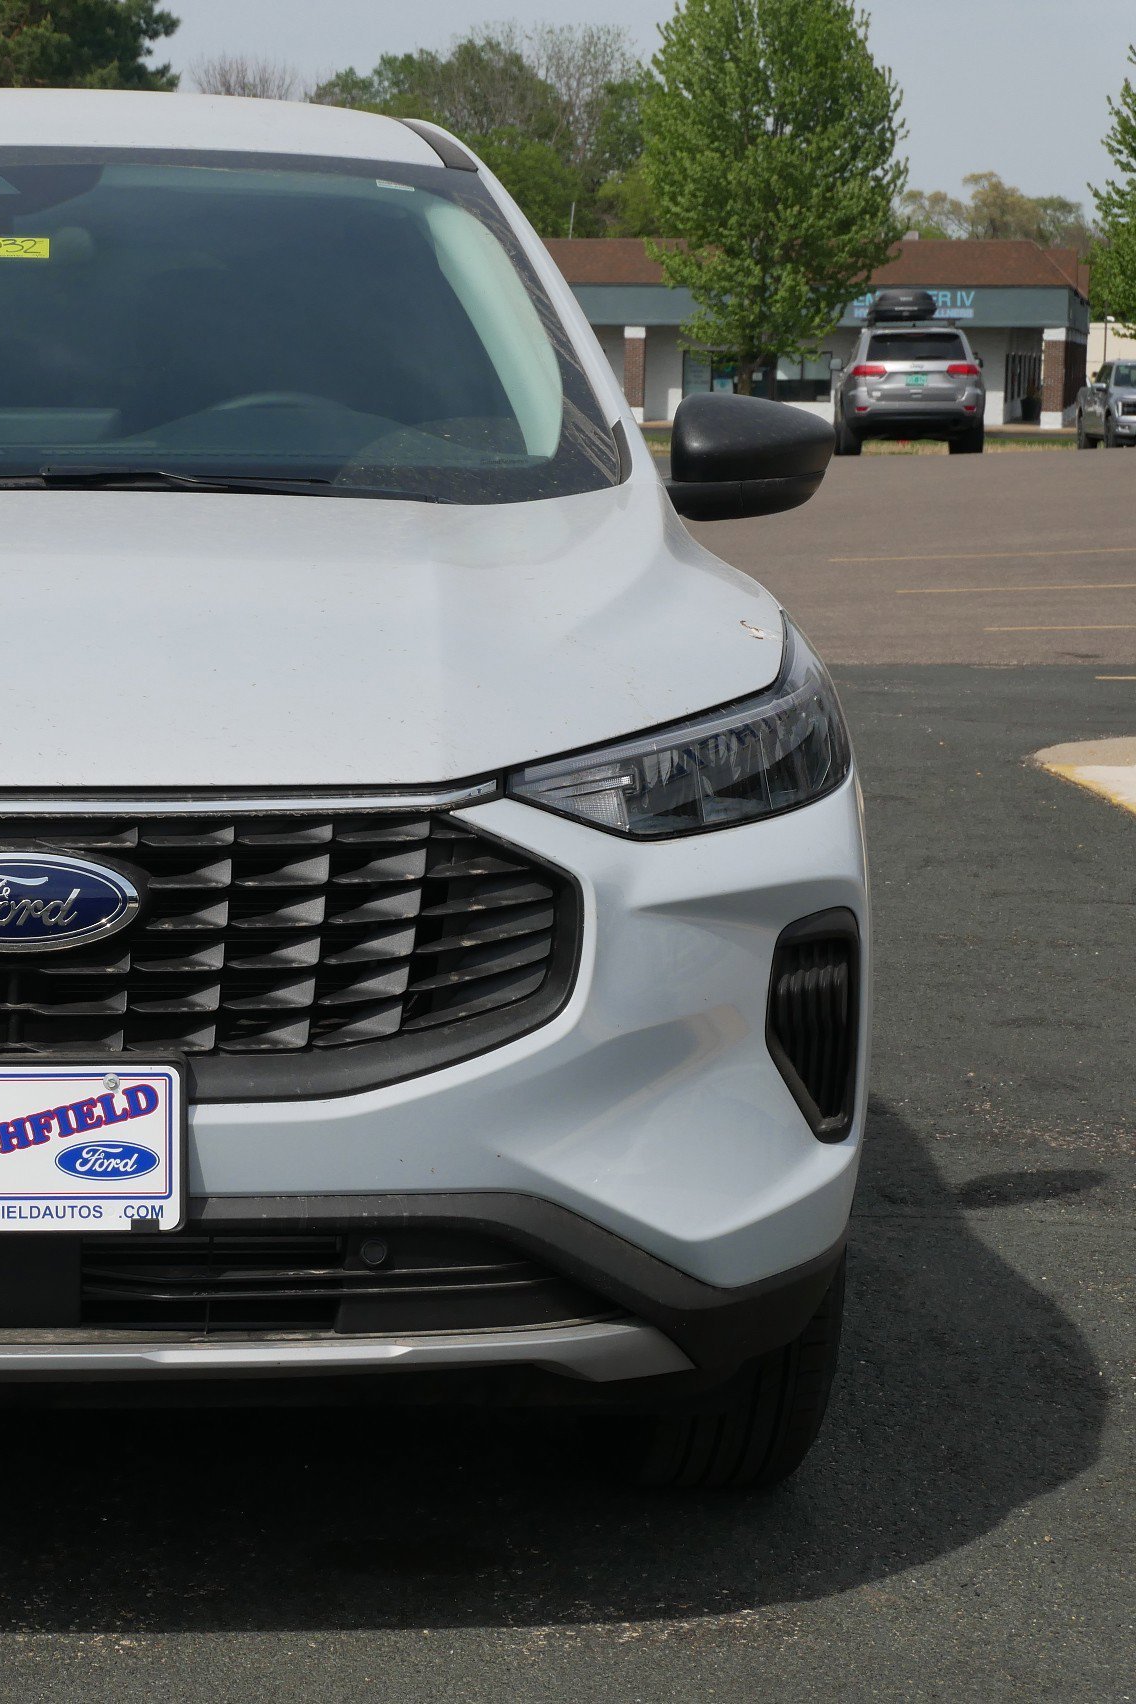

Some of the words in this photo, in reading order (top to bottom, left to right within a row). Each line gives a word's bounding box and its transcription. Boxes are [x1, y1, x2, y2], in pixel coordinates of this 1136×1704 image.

[956, 290, 975, 307] IV
[75, 1146, 139, 1172] Ford
[118, 1204, 165, 1220] .COM
